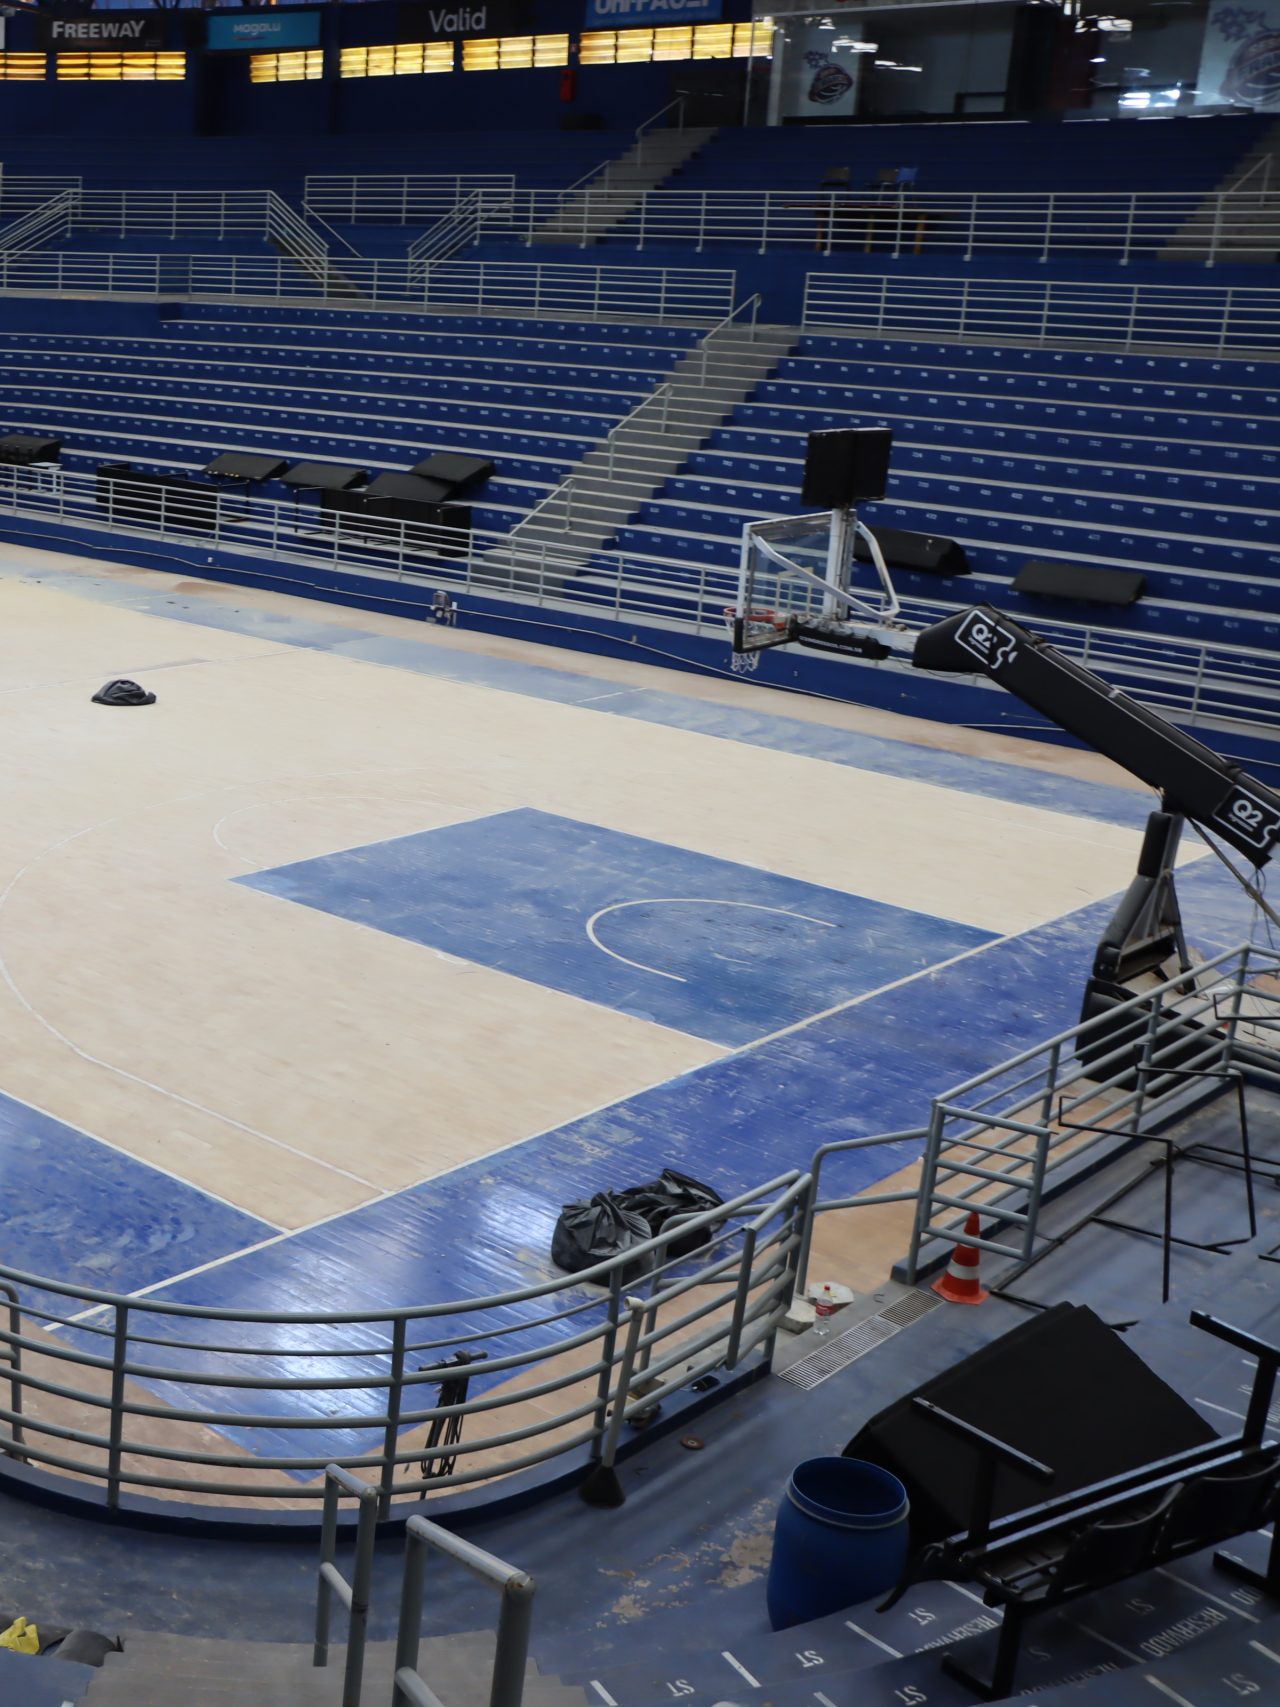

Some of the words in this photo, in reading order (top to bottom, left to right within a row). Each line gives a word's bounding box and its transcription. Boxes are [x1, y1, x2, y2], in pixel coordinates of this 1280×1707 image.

[52, 20, 145, 38] FREEWAY
[429, 7, 487, 33] Valid
[907, 1607, 936, 1627] ST
[1140, 1606, 1228, 1657] RESERVADO
[795, 1650, 825, 1668] ST
[666, 1679, 696, 1697] ST
[1222, 1672, 1261, 1697] ST
[894, 1685, 928, 1706] ST
